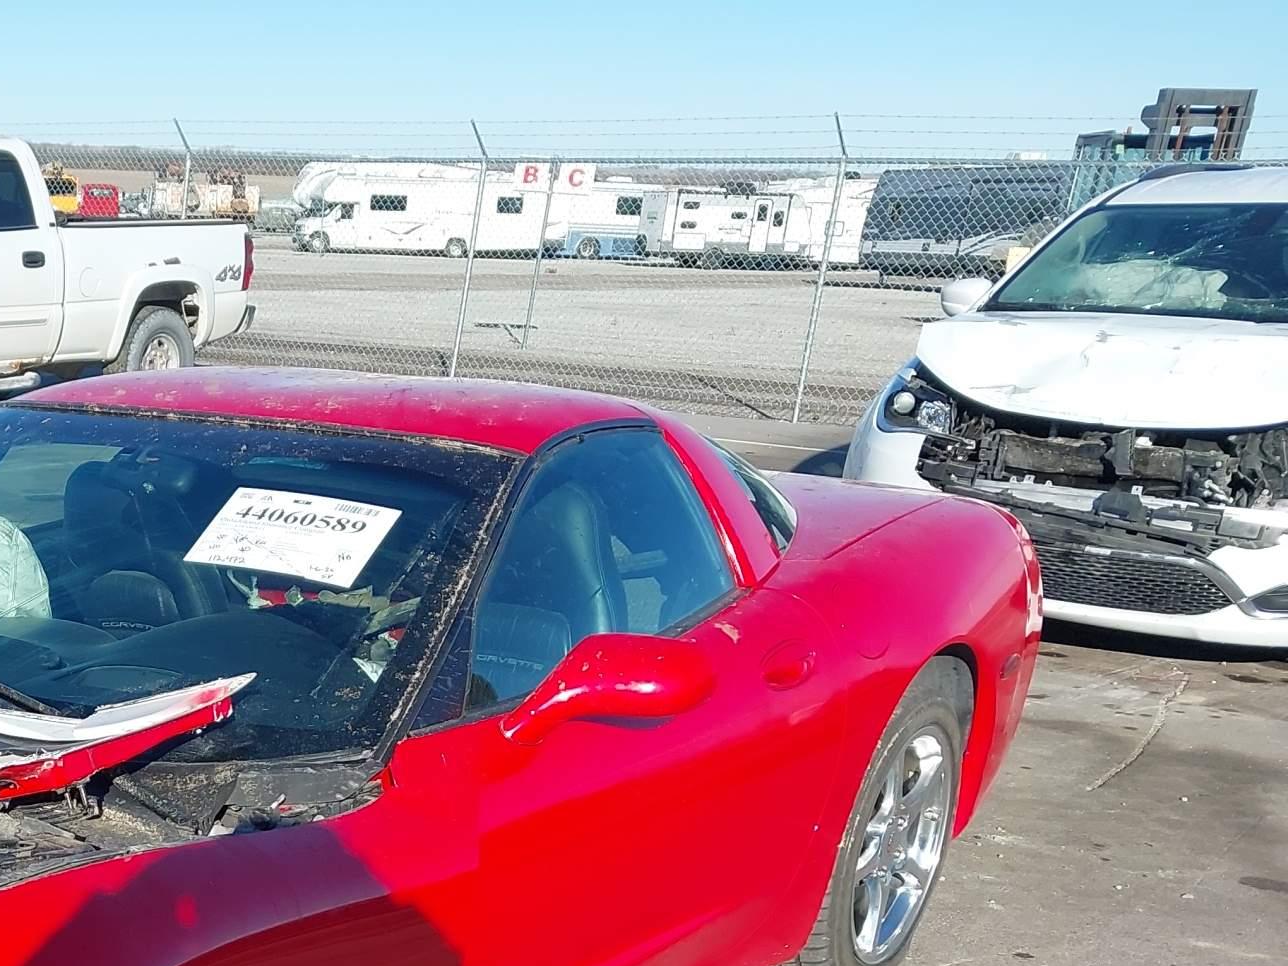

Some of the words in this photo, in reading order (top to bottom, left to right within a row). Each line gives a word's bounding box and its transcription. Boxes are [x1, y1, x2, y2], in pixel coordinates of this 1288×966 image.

[523, 166, 538, 183] B
[569, 169, 585, 187] C
[236, 506, 367, 533] 44060589
[101, 621, 153, 630] CORVET
[476, 654, 544, 671] ORVETTE
